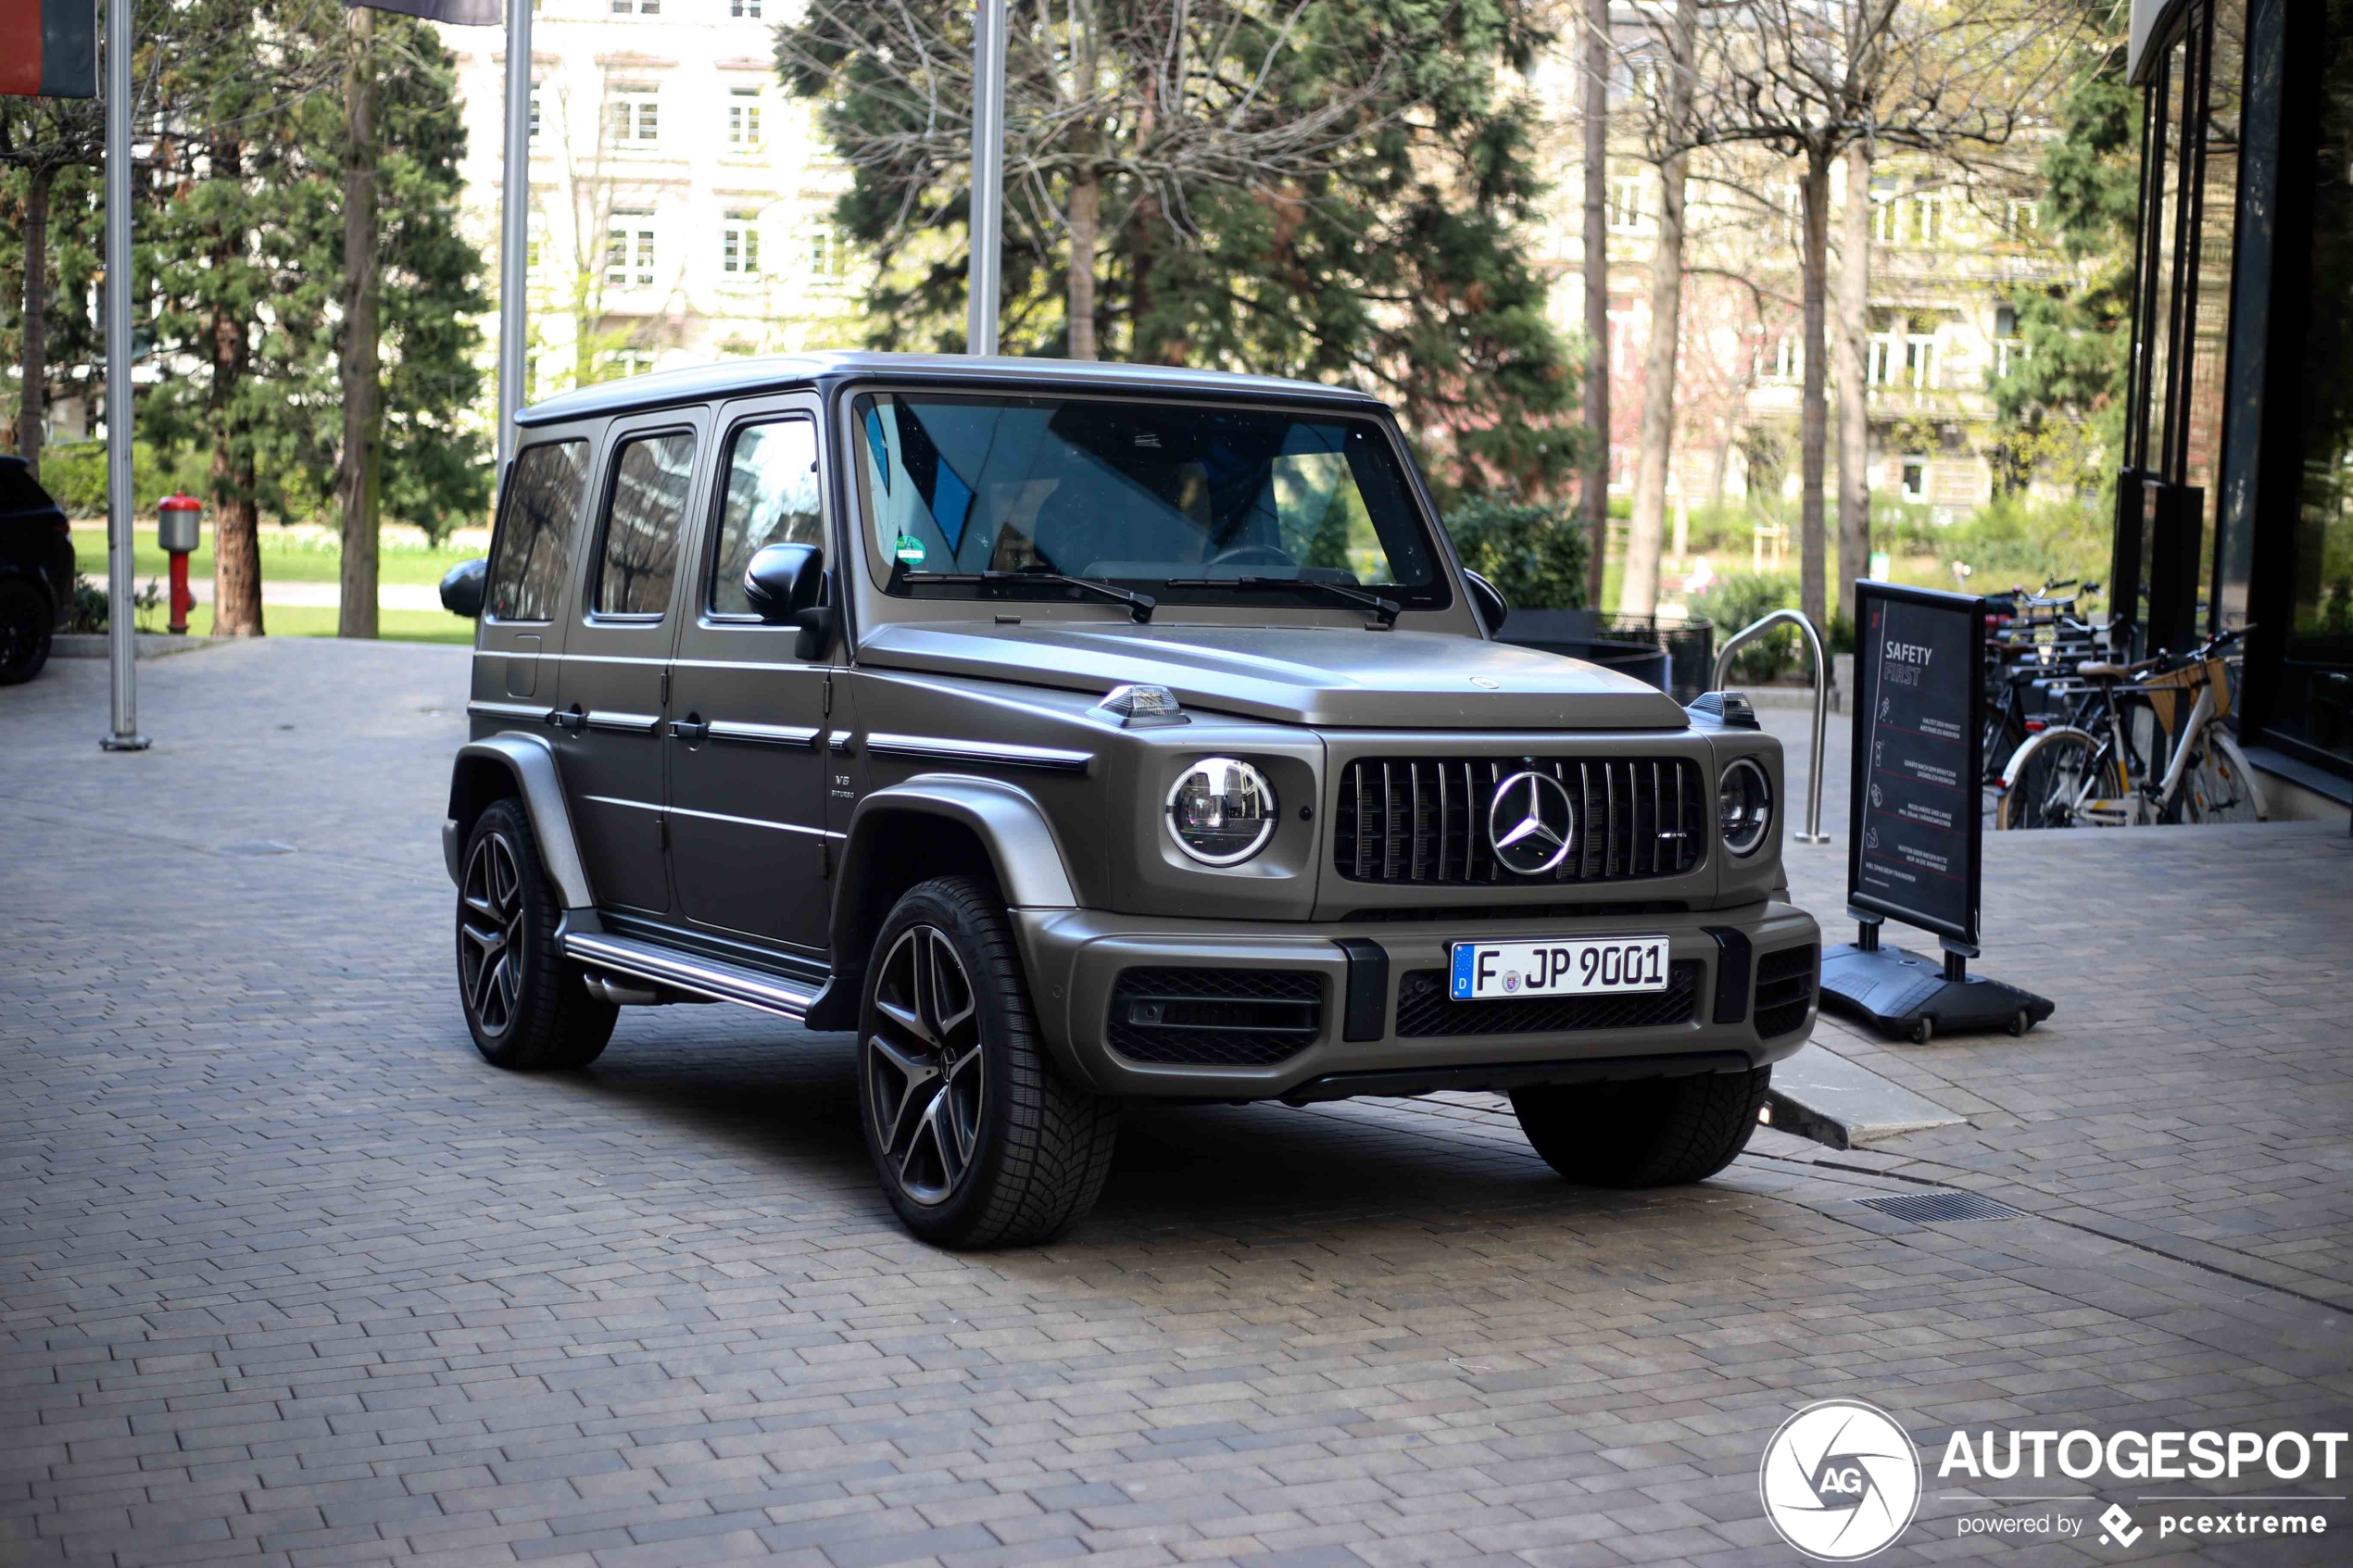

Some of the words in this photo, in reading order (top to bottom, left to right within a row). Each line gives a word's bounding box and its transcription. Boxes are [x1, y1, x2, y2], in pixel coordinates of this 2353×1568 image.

[1885, 641, 1932, 666] SAFETY
[1883, 661, 1921, 685] FIRST
[831, 789, 854, 798] BITURBO
[1477, 950, 1500, 991] F
[1525, 947, 1571, 989] JP
[1579, 945, 1663, 986] 9001
[1458, 978, 1467, 990] D
